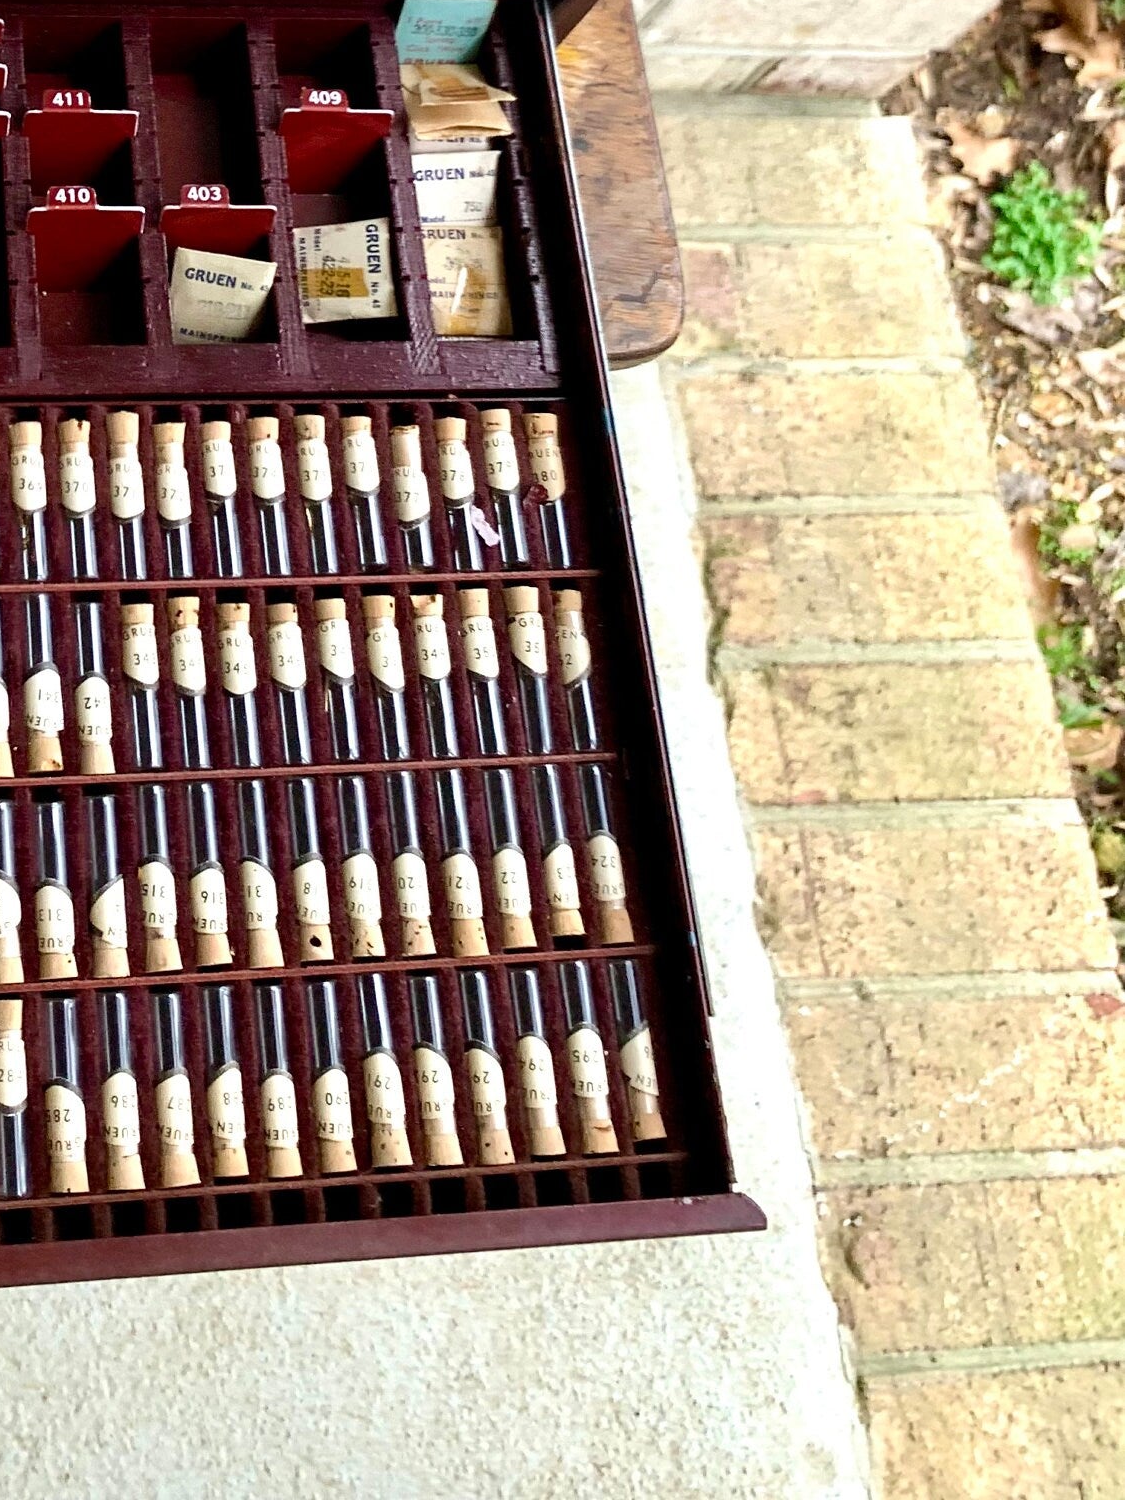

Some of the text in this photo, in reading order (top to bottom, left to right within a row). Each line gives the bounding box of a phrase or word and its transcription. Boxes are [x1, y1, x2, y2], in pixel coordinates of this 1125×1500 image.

[52, 93, 84, 107] 411
[308, 91, 341, 106] 409
[414, 168, 465, 181] GRUEN
[55, 188, 90, 203] 410
[187, 187, 222, 201] 403
[365, 224, 381, 274] GRUEN
[184, 267, 237, 288] GRUEN
